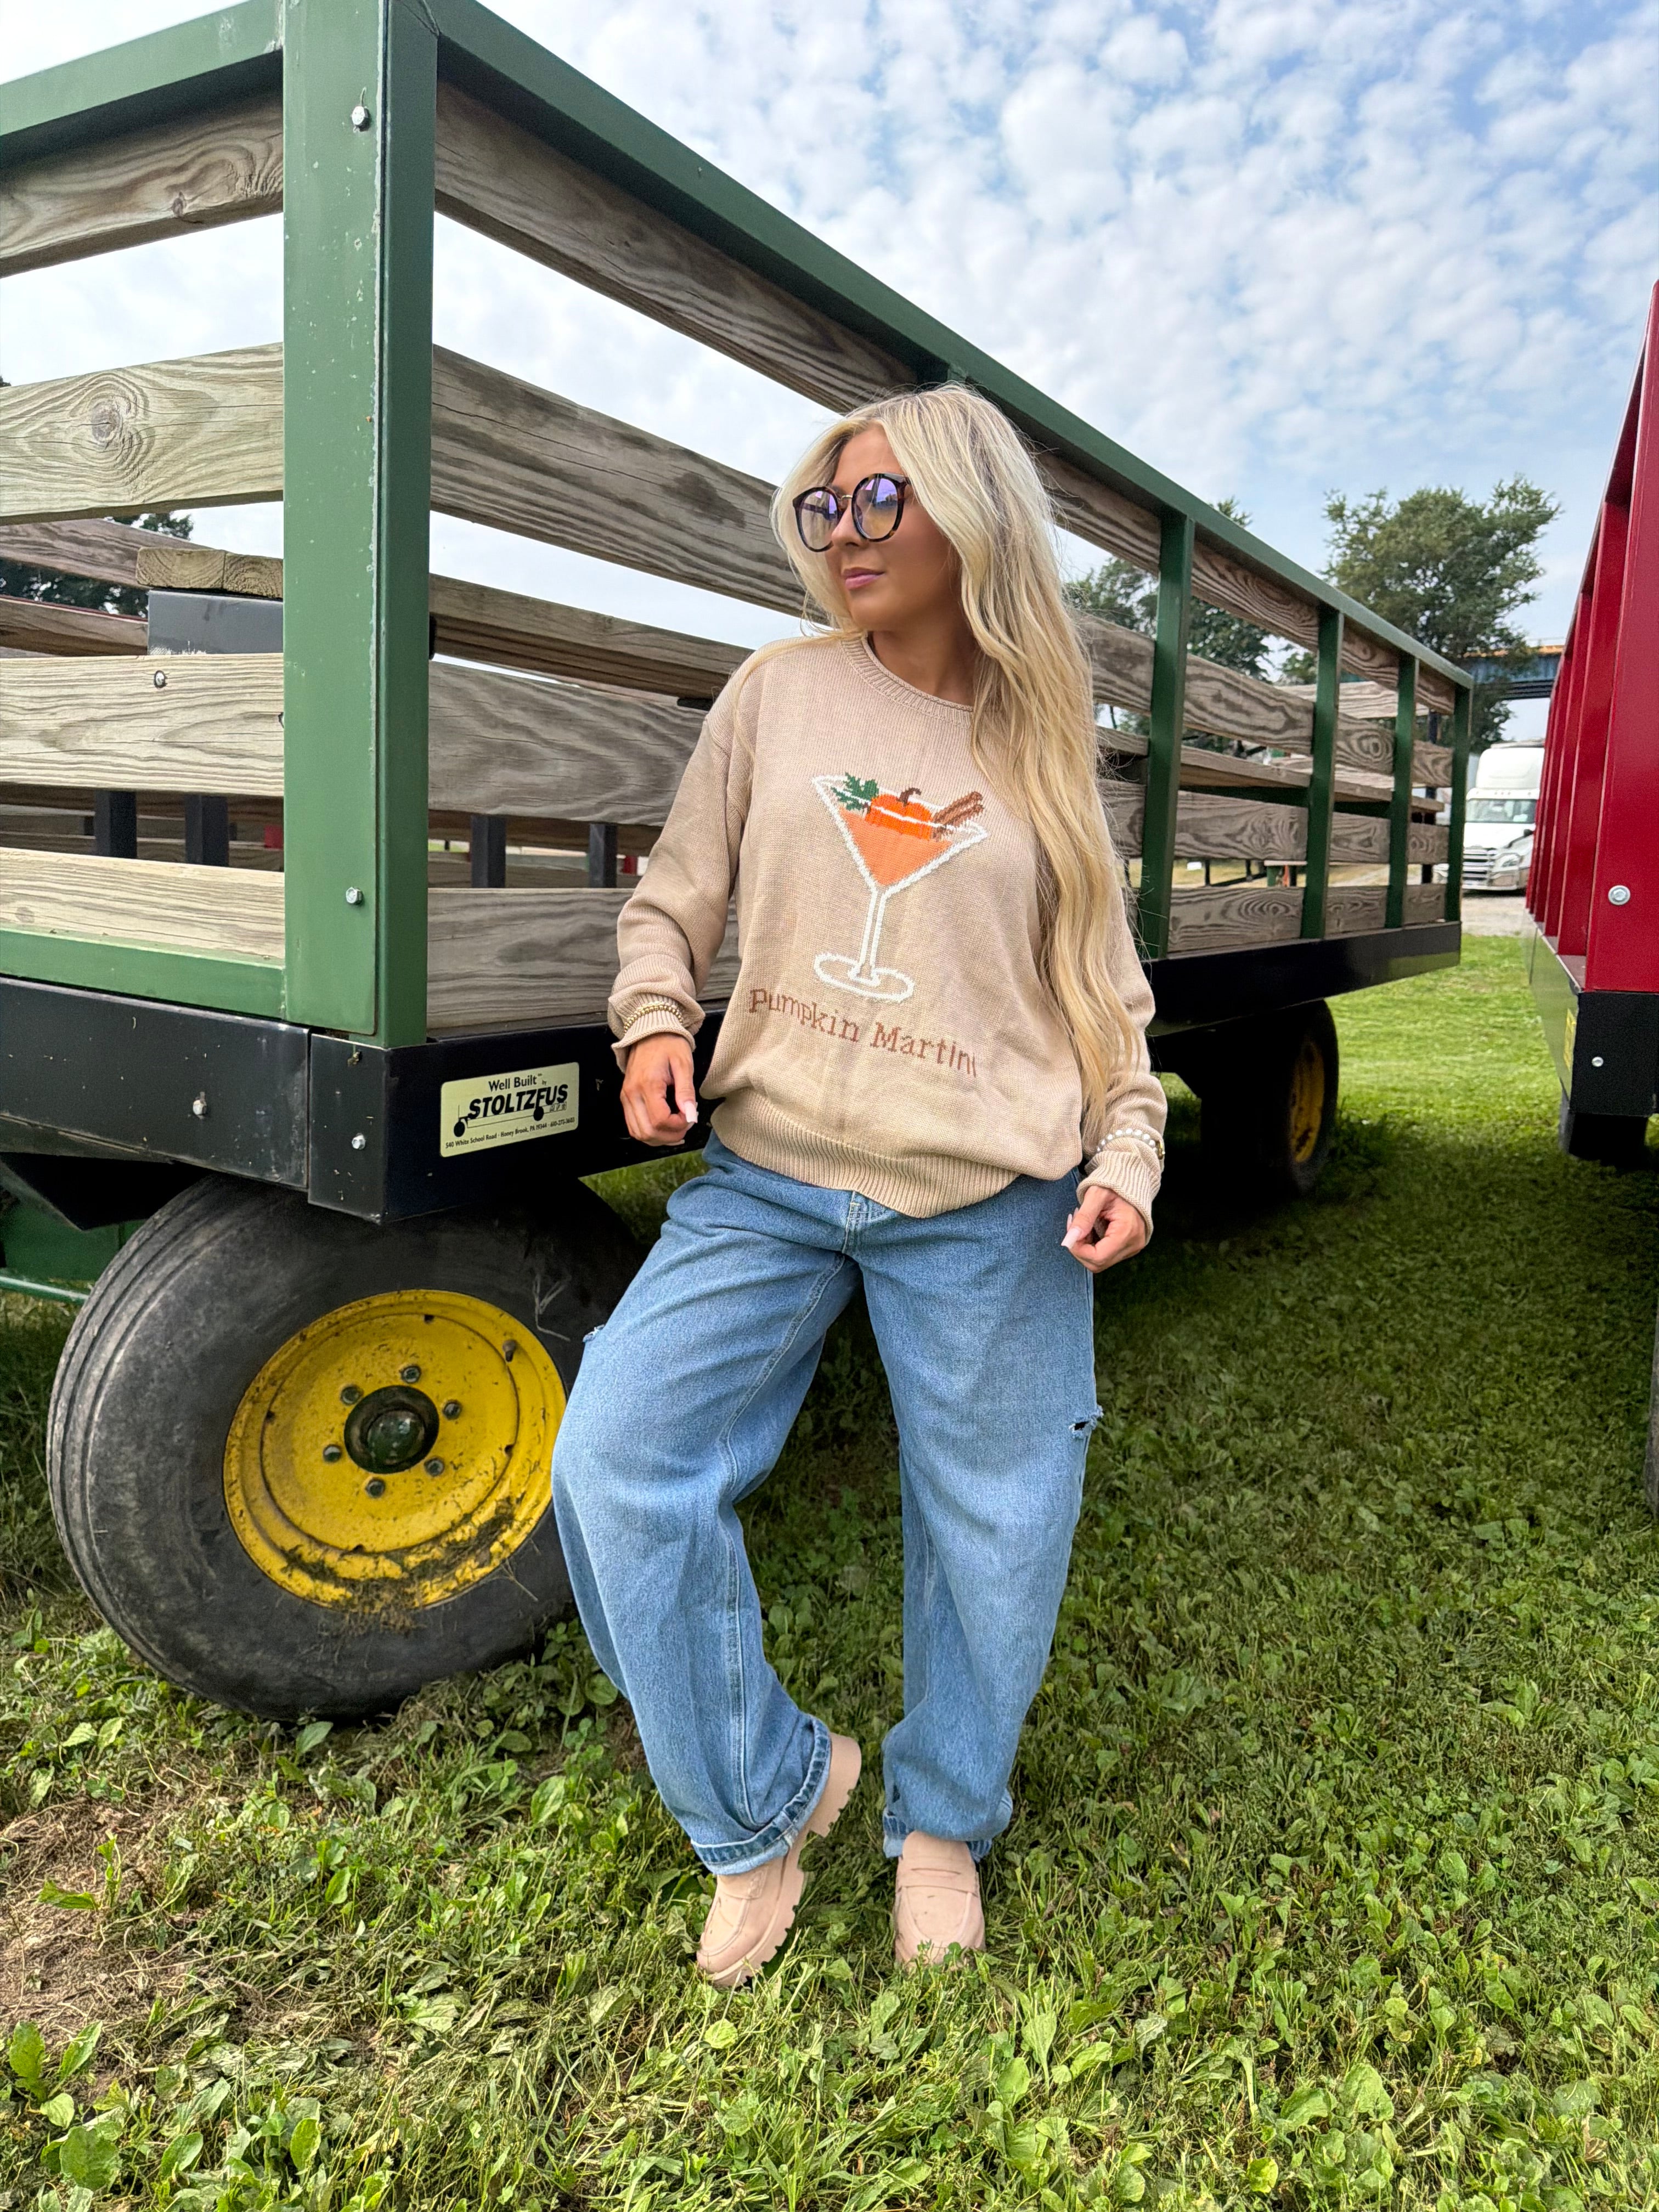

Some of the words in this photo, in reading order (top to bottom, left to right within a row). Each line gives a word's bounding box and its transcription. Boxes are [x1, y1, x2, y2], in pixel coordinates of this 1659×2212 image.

[749, 988, 859, 1042] Pumpkin
[870, 1022, 977, 1077] Martini
[488, 1079, 510, 1092] Well
[514, 1075, 537, 1087] Built
[467, 1084, 568, 1119] STOLTZFUS
[470, 1135, 485, 1144] School
[486, 1132, 497, 1141] Road
